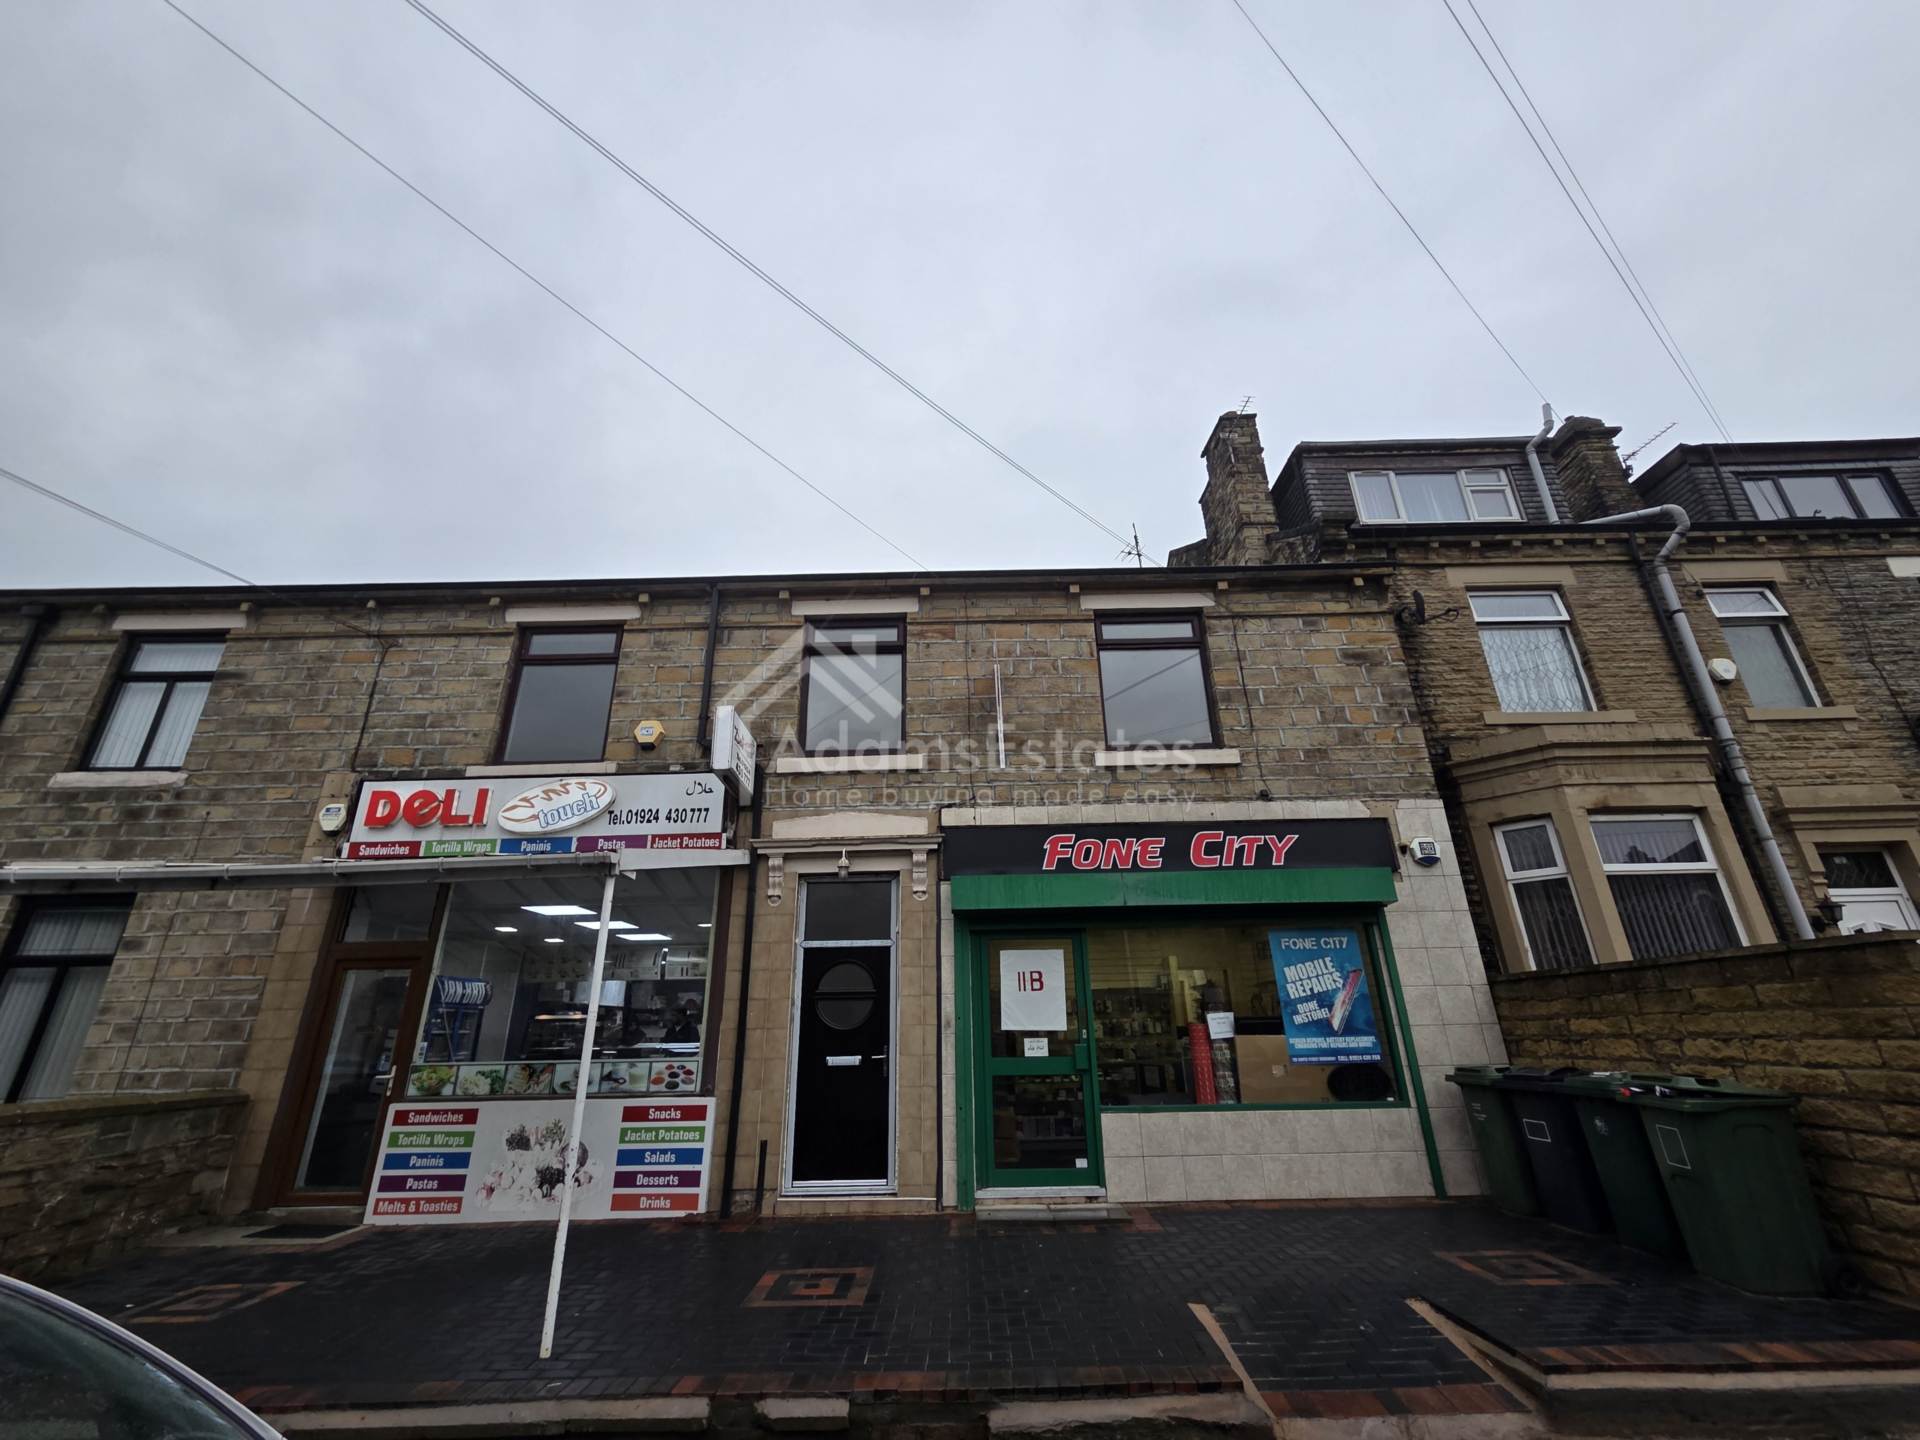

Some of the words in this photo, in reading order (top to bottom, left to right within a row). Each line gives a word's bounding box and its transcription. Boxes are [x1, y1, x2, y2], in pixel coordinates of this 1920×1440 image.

[685, 780, 714, 796] حلال
[537, 792, 600, 829] touch
[431, 841, 462, 853] Tortilla
[463, 841, 492, 853] Wraps
[520, 839, 552, 852] Paninis
[597, 838, 626, 850] Pastas
[653, 836, 681, 848] Jacket
[682, 835, 720, 848] Potatoes
[359, 844, 410, 856] Sandwiches
[1042, 833, 1166, 870] FONE
[1190, 831, 1299, 868] CITY
[1281, 938, 1318, 950] FONE
[1320, 937, 1348, 949] CITY
[1283, 956, 1336, 982] MOBILE
[1286, 971, 1344, 1000] REPAIRS
[1296, 1000, 1320, 1013] DONE
[408, 1112, 464, 1123] Sandwiches
[648, 1108, 682, 1119] Snacks
[397, 1133, 431, 1145] Tortilla
[433, 1133, 465, 1147] Wraps
[625, 1130, 656, 1141] Jacket
[658, 1129, 700, 1141] Potatoes
[409, 1155, 445, 1167] Paninis
[644, 1151, 676, 1163] Salads
[405, 1177, 438, 1190] Pastas
[636, 1174, 679, 1186] Desserts
[377, 1201, 406, 1213] Melts
[408, 1200, 417, 1212] &
[419, 1200, 459, 1212] Toasties
[640, 1196, 671, 1209] Drinks
